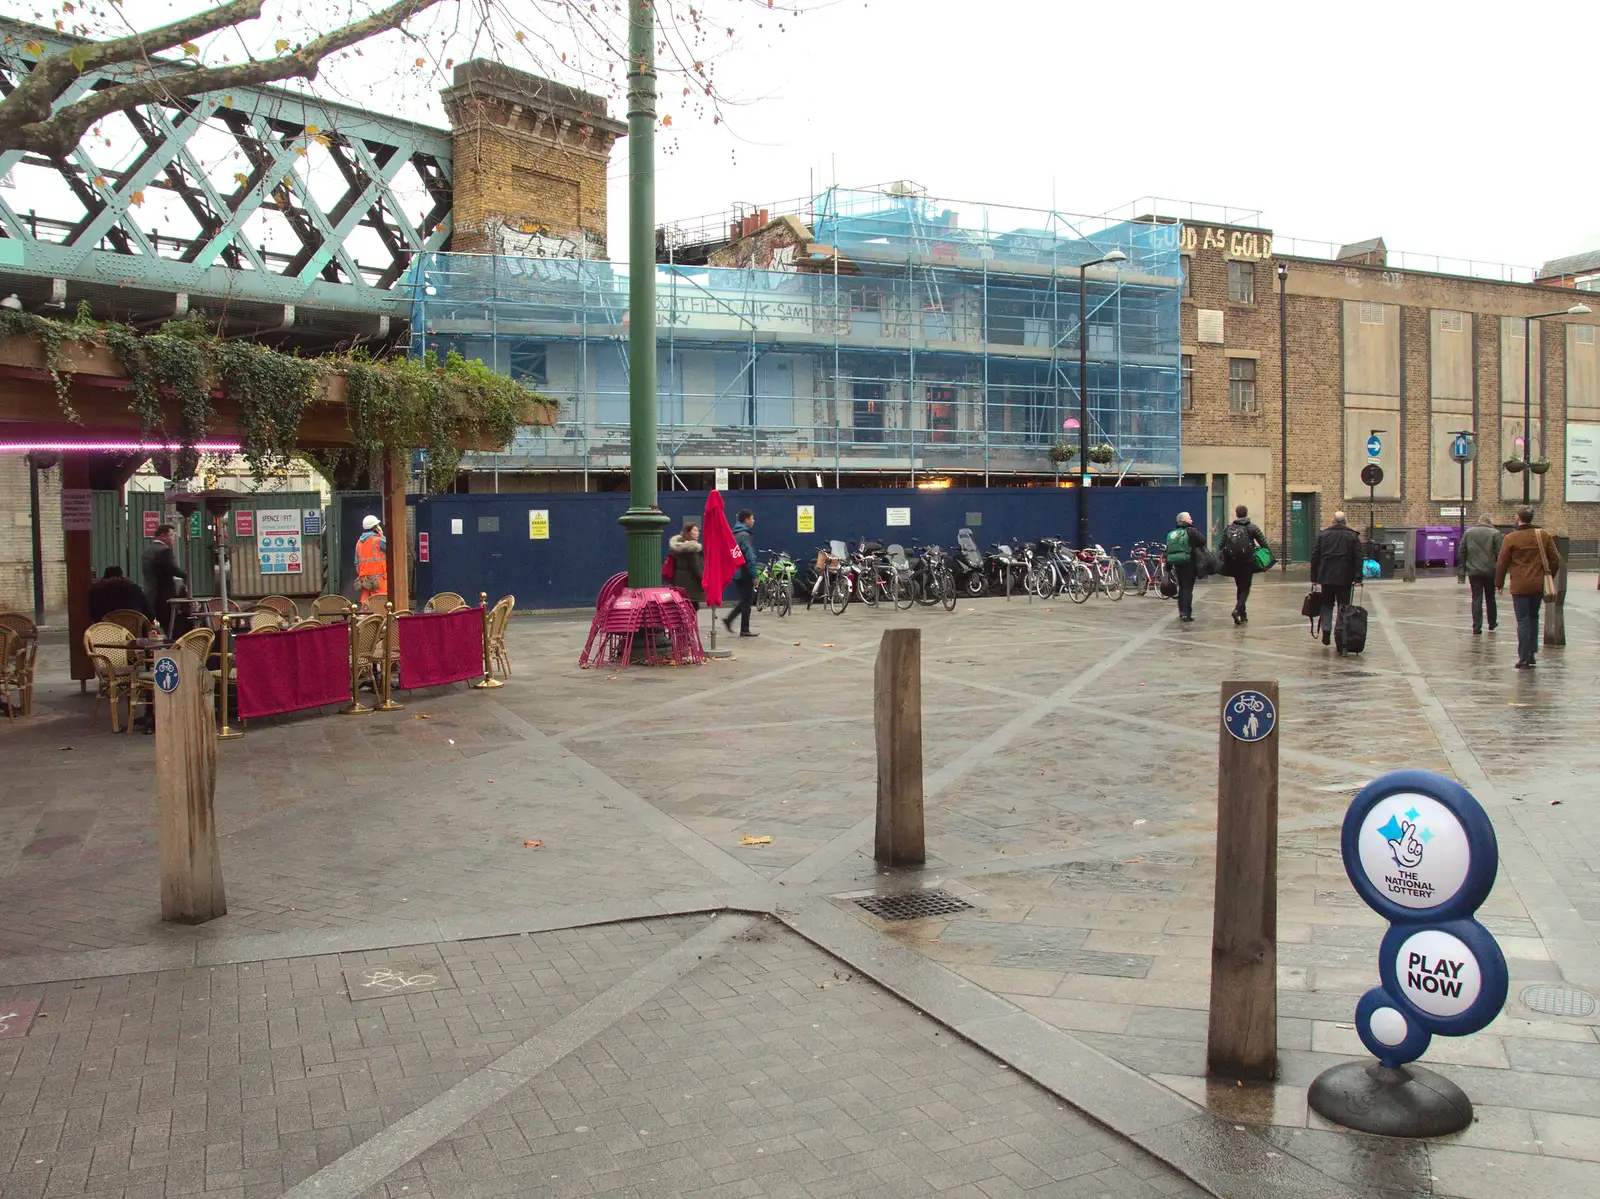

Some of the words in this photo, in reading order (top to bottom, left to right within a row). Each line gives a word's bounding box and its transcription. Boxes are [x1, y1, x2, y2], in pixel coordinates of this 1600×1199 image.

[1203, 227, 1225, 250] AS
[1230, 231, 1273, 259] GOLD
[1385, 875, 1436, 891] NATIONAL
[1398, 870, 1418, 881] THE
[1388, 884, 1432, 899] LOTTERY
[1408, 952, 1465, 979] PLAY
[1407, 971, 1463, 998] NOW
